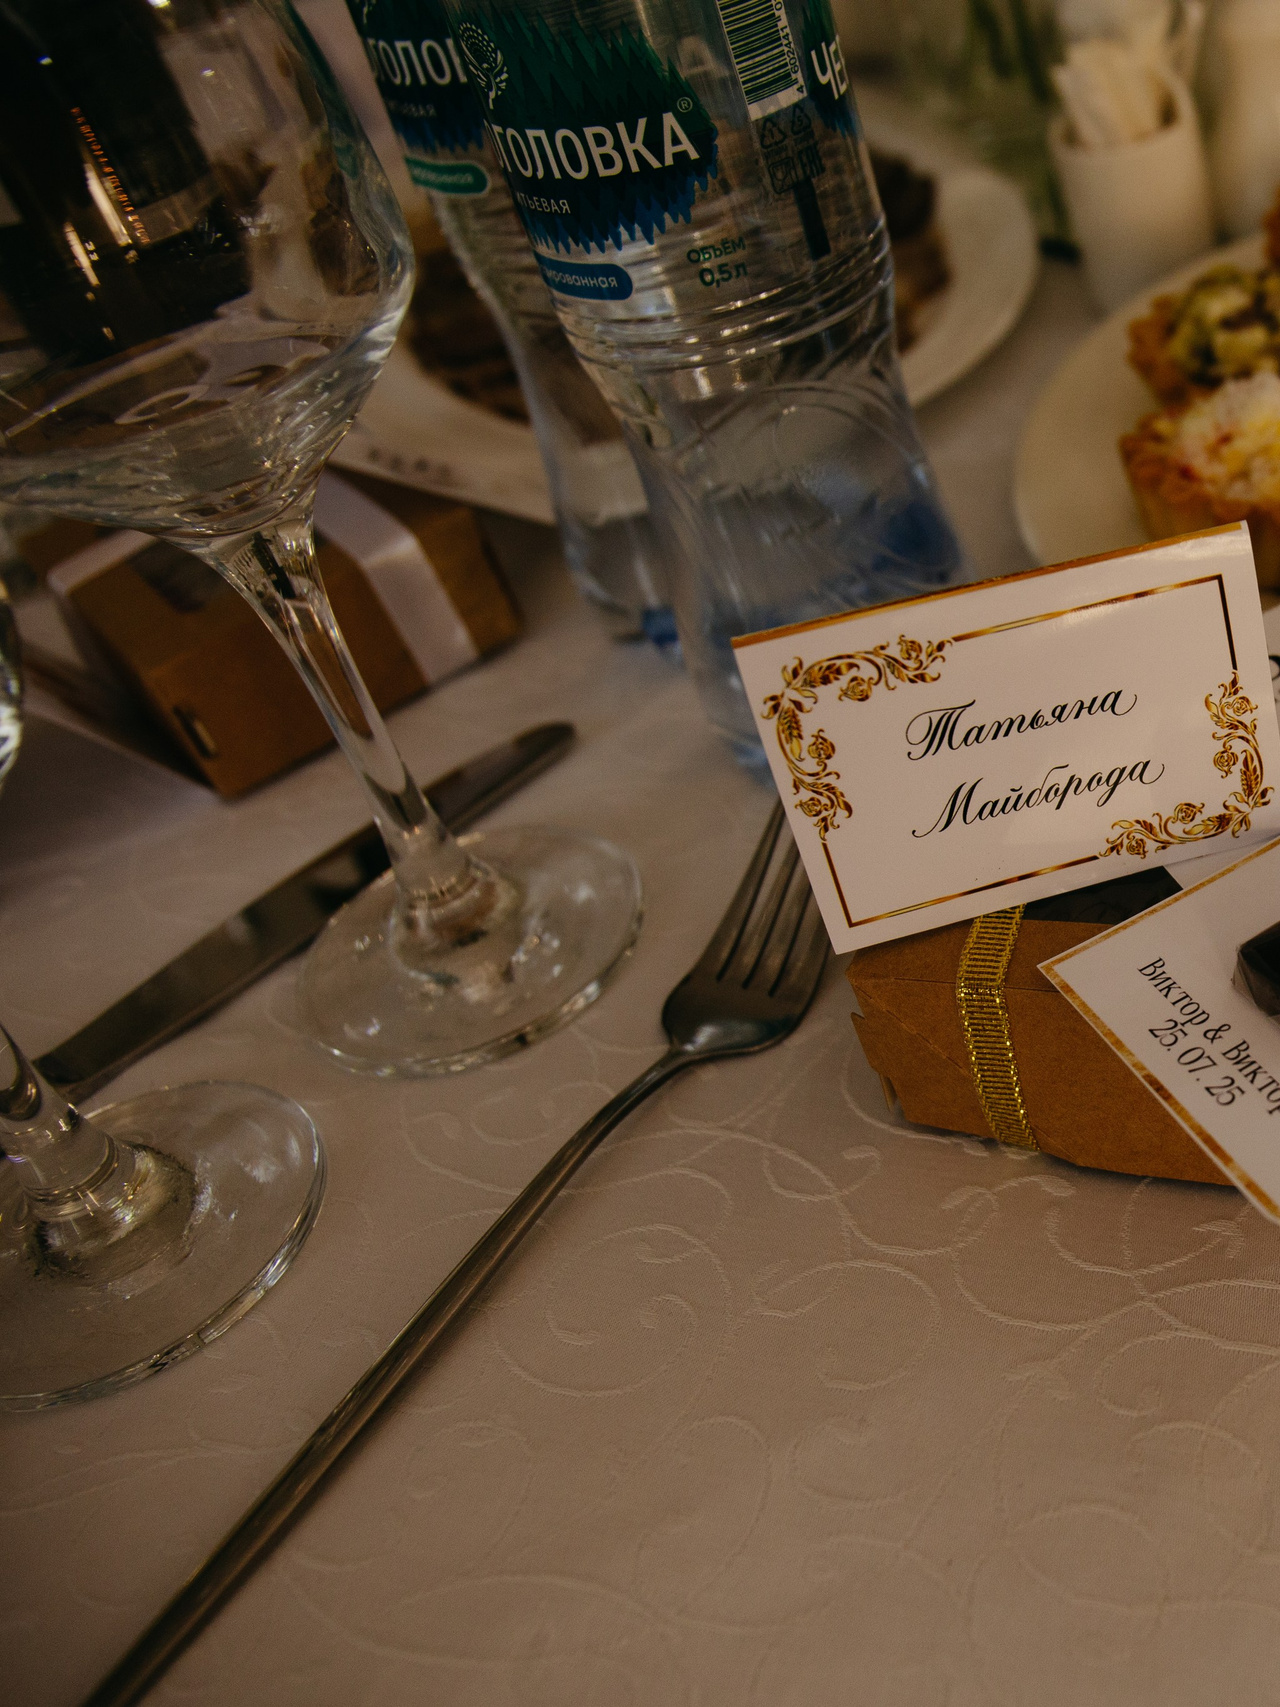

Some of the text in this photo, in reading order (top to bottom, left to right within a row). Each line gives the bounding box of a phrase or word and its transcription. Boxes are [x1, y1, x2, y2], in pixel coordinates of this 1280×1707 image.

[687, 236, 746, 263] ОБЪЁМ
[905, 688, 1138, 761] Татьяна
[911, 758, 1166, 838] Майборода
[1136, 956, 1211, 1028] Виктор
[1203, 1023, 1232, 1044] &
[1148, 1018, 1247, 1107] 25. 07. 25
